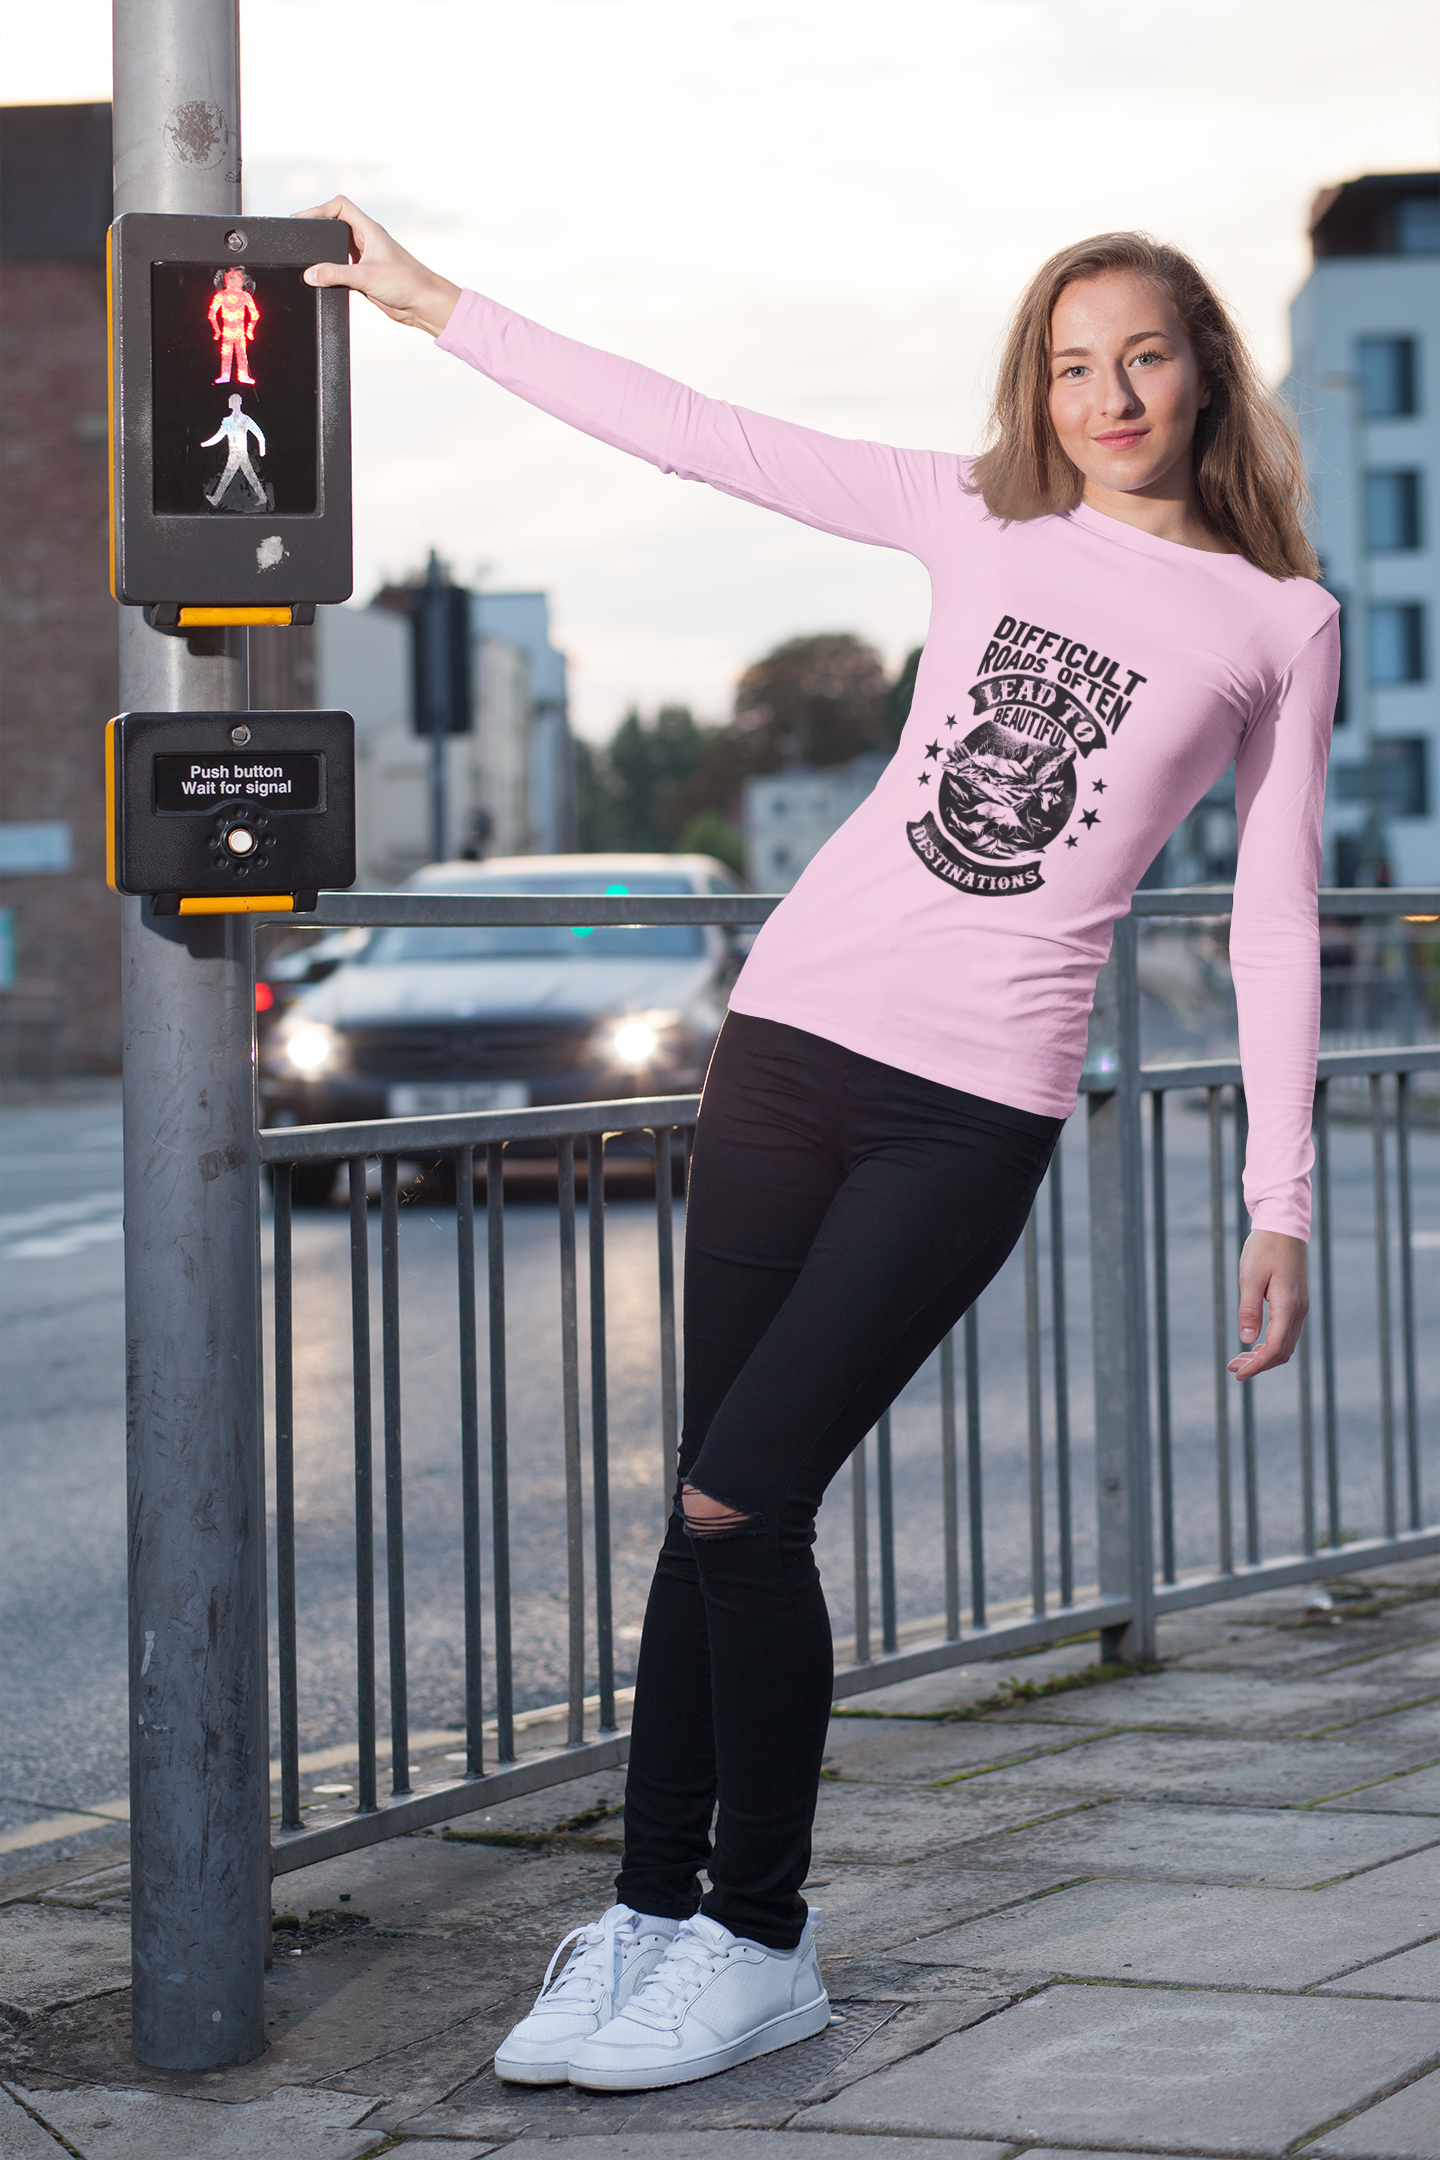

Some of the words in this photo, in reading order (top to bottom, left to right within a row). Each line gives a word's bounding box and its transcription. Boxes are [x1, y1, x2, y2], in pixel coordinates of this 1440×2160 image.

[993, 615, 1147, 696] DIFFICULT
[976, 640, 1049, 677] ROADS
[1057, 667, 1132, 736] OFTEN
[981, 679, 1057, 707] LEAD
[1058, 698, 1097, 742] TO
[993, 706, 1067, 751] BEAUTIFUL
[181, 781, 216, 795] Wait
[220, 781, 242, 794] for
[245, 780, 292, 797] signal
[190, 765, 230, 779] Push
[234, 765, 283, 778] button
[911, 825, 1038, 890] DESTINATIONS
